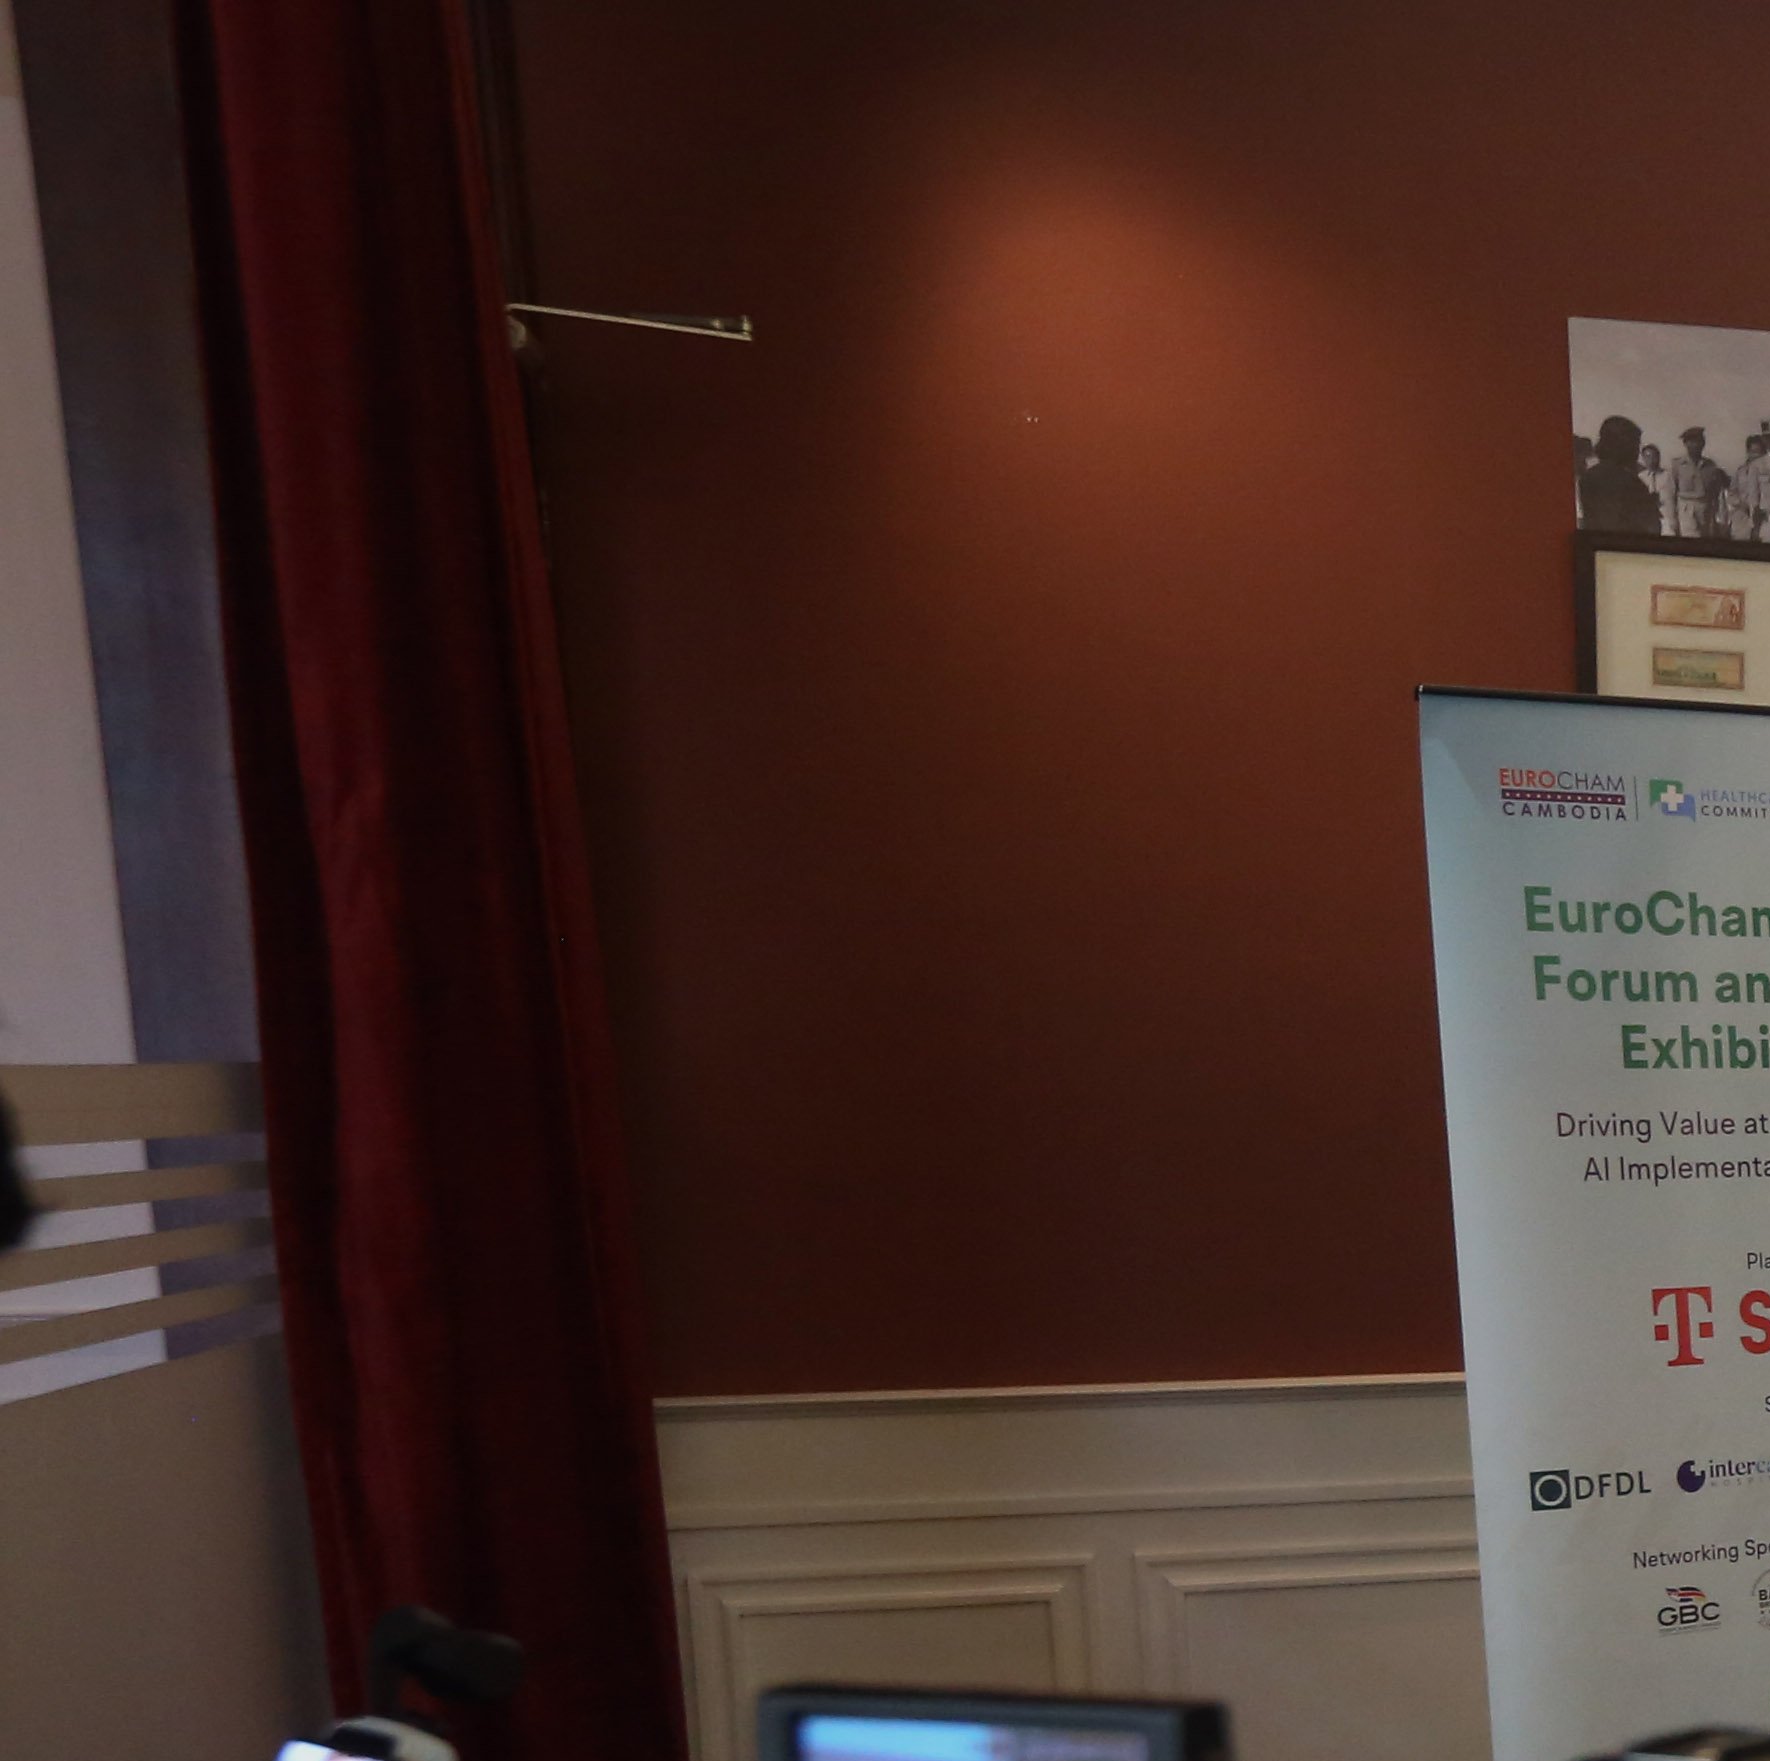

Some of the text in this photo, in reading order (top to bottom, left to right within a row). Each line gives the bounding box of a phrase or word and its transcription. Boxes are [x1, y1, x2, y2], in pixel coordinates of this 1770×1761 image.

[1500, 767, 1626, 792] EUROCHAM
[1503, 802, 1627, 821] CAMBODIA
[1533, 955, 1698, 1002] Forum
[1556, 1111, 1652, 1143] Driving
[1660, 1111, 1735, 1137] Value
[1744, 1113, 1769, 1135] at
[1584, 1157, 1609, 1182] AI
[1651, 1286, 1714, 1367] T
[1575, 1470, 1652, 1500] DFDL
[1633, 1542, 1739, 1569] Networking
[1658, 1602, 1720, 1626] GBC
